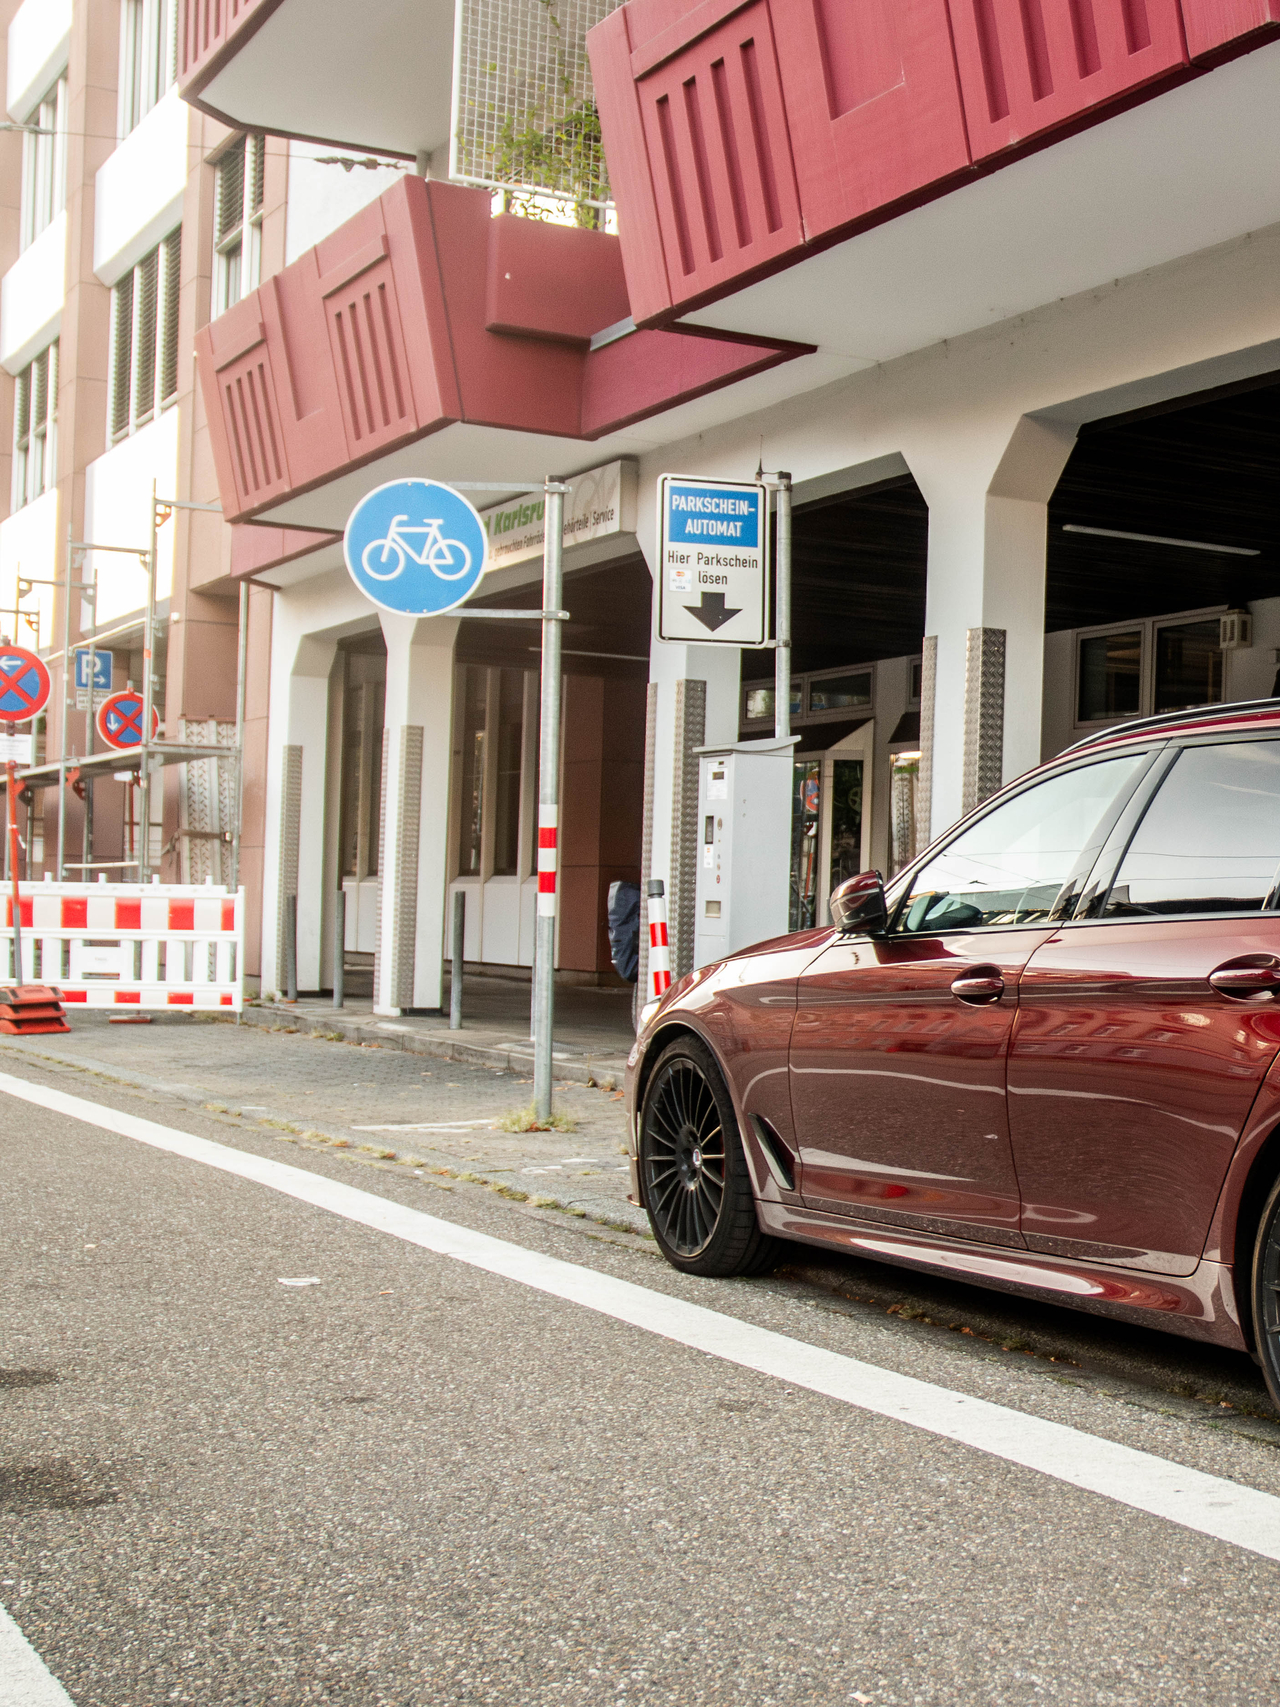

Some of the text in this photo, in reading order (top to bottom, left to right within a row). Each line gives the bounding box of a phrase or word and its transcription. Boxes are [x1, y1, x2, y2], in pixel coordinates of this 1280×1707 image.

[671, 494, 756, 516] PARKSCHEIN-
[494, 501, 545, 536] Karlsru
[563, 513, 589, 536] ehörteile
[592, 505, 615, 527] Service
[685, 518, 744, 538] AUTOMAT
[667, 550, 759, 569] Hier Parkschein
[698, 570, 728, 585] lösen
